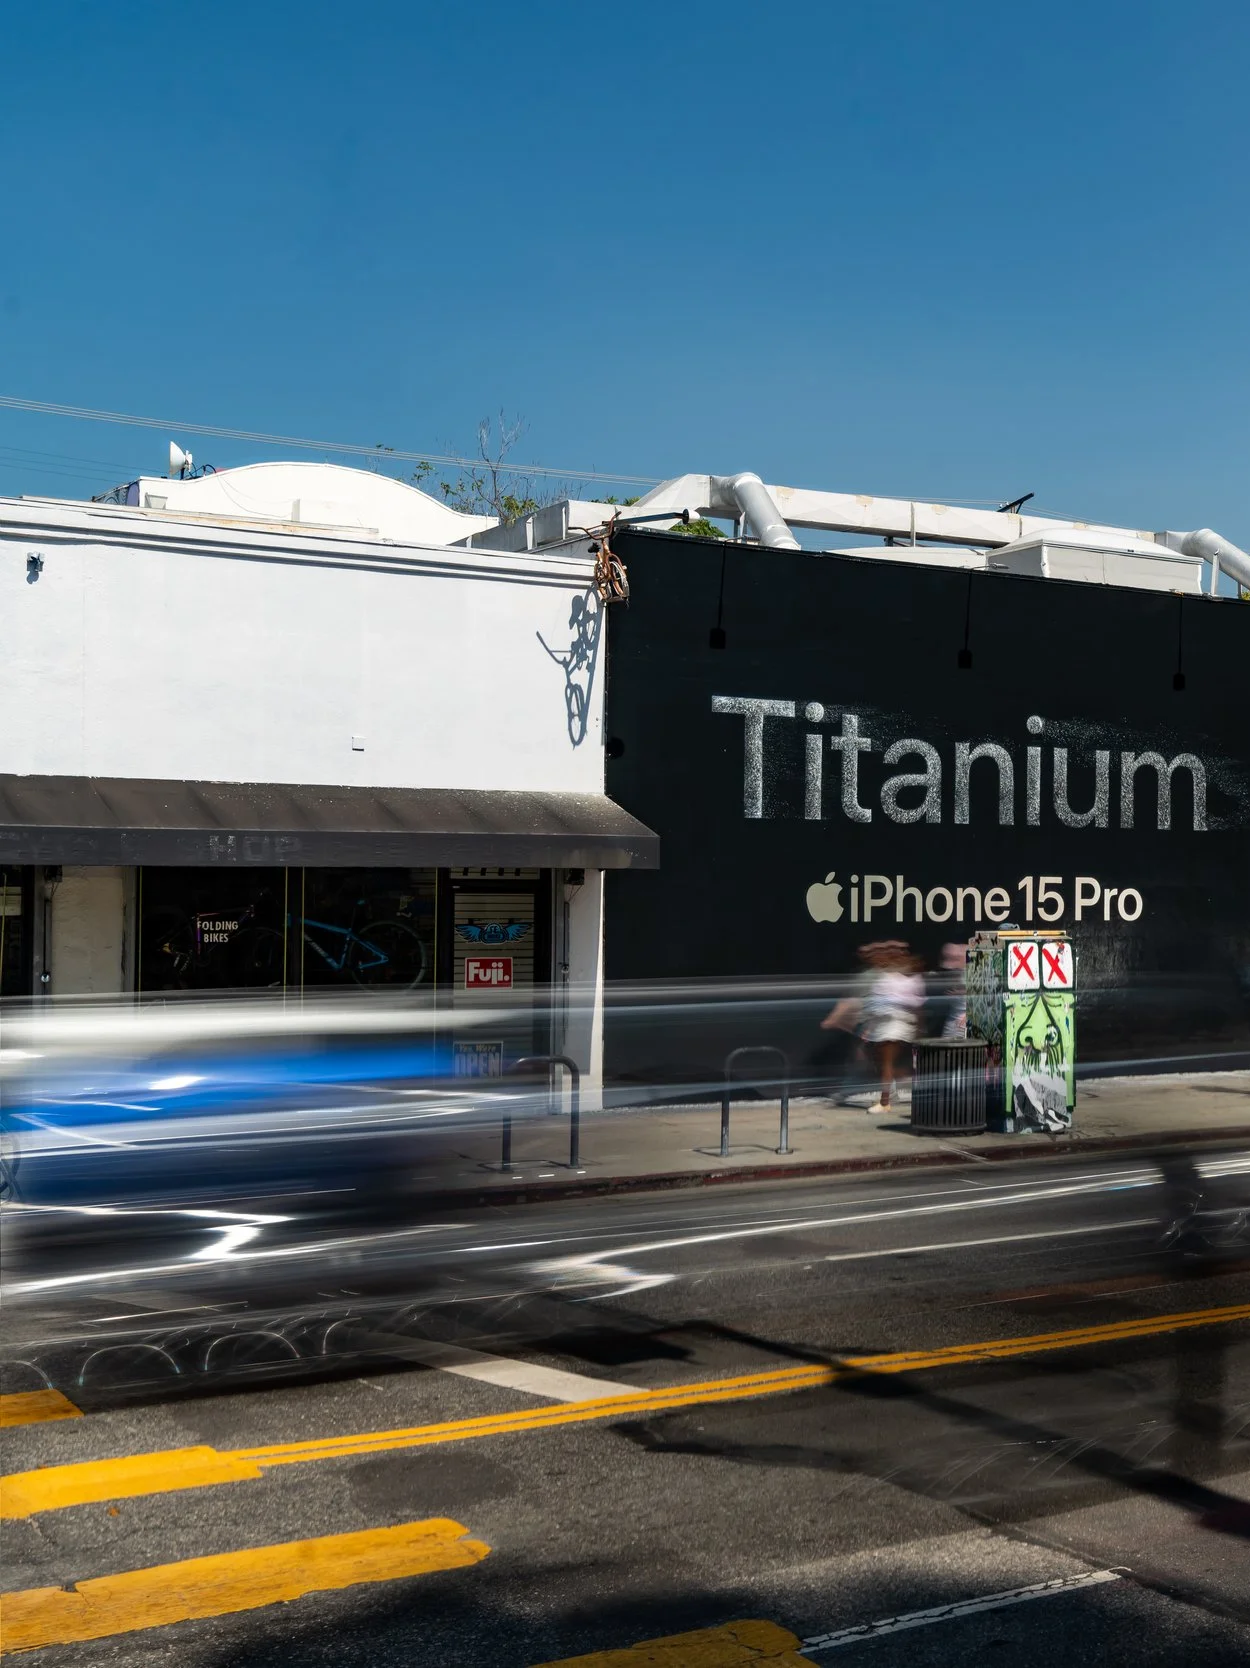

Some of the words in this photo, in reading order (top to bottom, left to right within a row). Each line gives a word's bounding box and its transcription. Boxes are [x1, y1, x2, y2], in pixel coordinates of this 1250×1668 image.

[711, 695, 1209, 831] Titanium
[178, 834, 301, 862] HOP
[850, 874, 1011, 923] iPhone
[1017, 876, 1065, 922] 15
[1075, 876, 1143, 923] Pro
[197, 921, 239, 931] FOLDING
[203, 932, 229, 943] BIKES
[468, 961, 510, 985] Fuji.
[455, 1052, 500, 1077] OPEN
